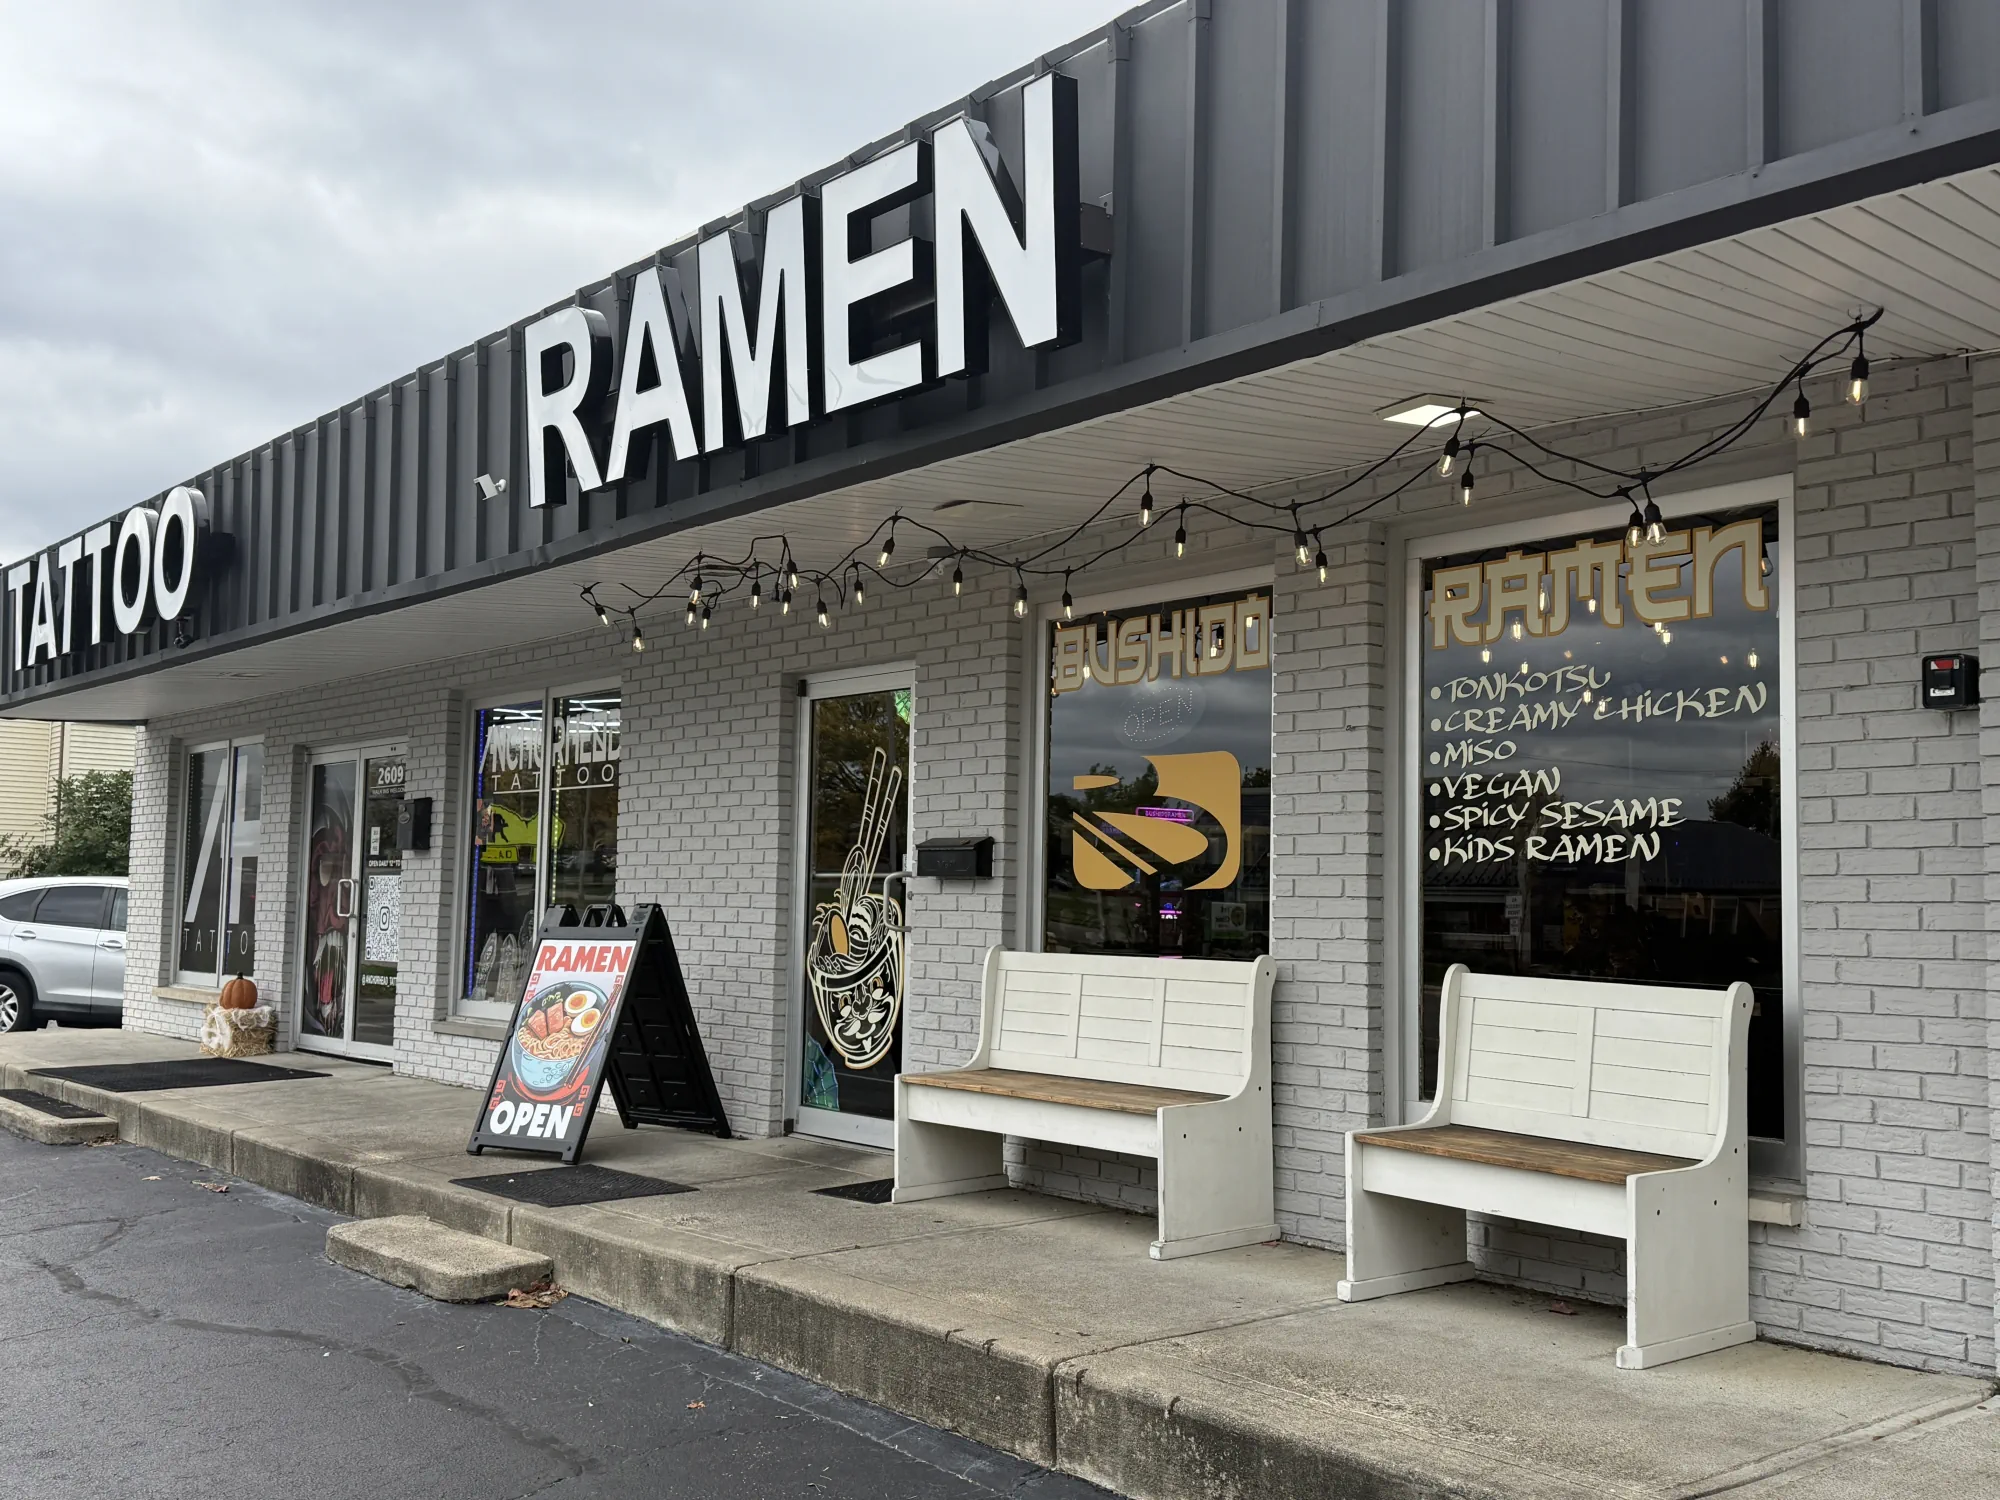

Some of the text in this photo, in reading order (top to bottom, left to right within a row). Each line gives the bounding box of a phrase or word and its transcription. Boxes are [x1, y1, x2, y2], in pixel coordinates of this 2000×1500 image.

[523, 72, 1058, 508] RAMEN
[8, 486, 195, 671] TATTOO
[1428, 518, 1769, 650] RAMEN
[1052, 593, 1270, 693] BUSHIDO
[1444, 665, 1611, 703] TONKOTSU
[1124, 687, 1192, 736] OPEN
[1445, 696, 1583, 734] CREAMY
[378, 765, 404, 785] 2609
[491, 764, 615, 792] TATTOO
[1443, 766, 1561, 800] VEGAN
[1540, 797, 1688, 829] SESAME
[1526, 831, 1661, 864] RAMEN
[535, 945, 633, 973] RAMEN
[489, 1100, 574, 1139] OPEN
